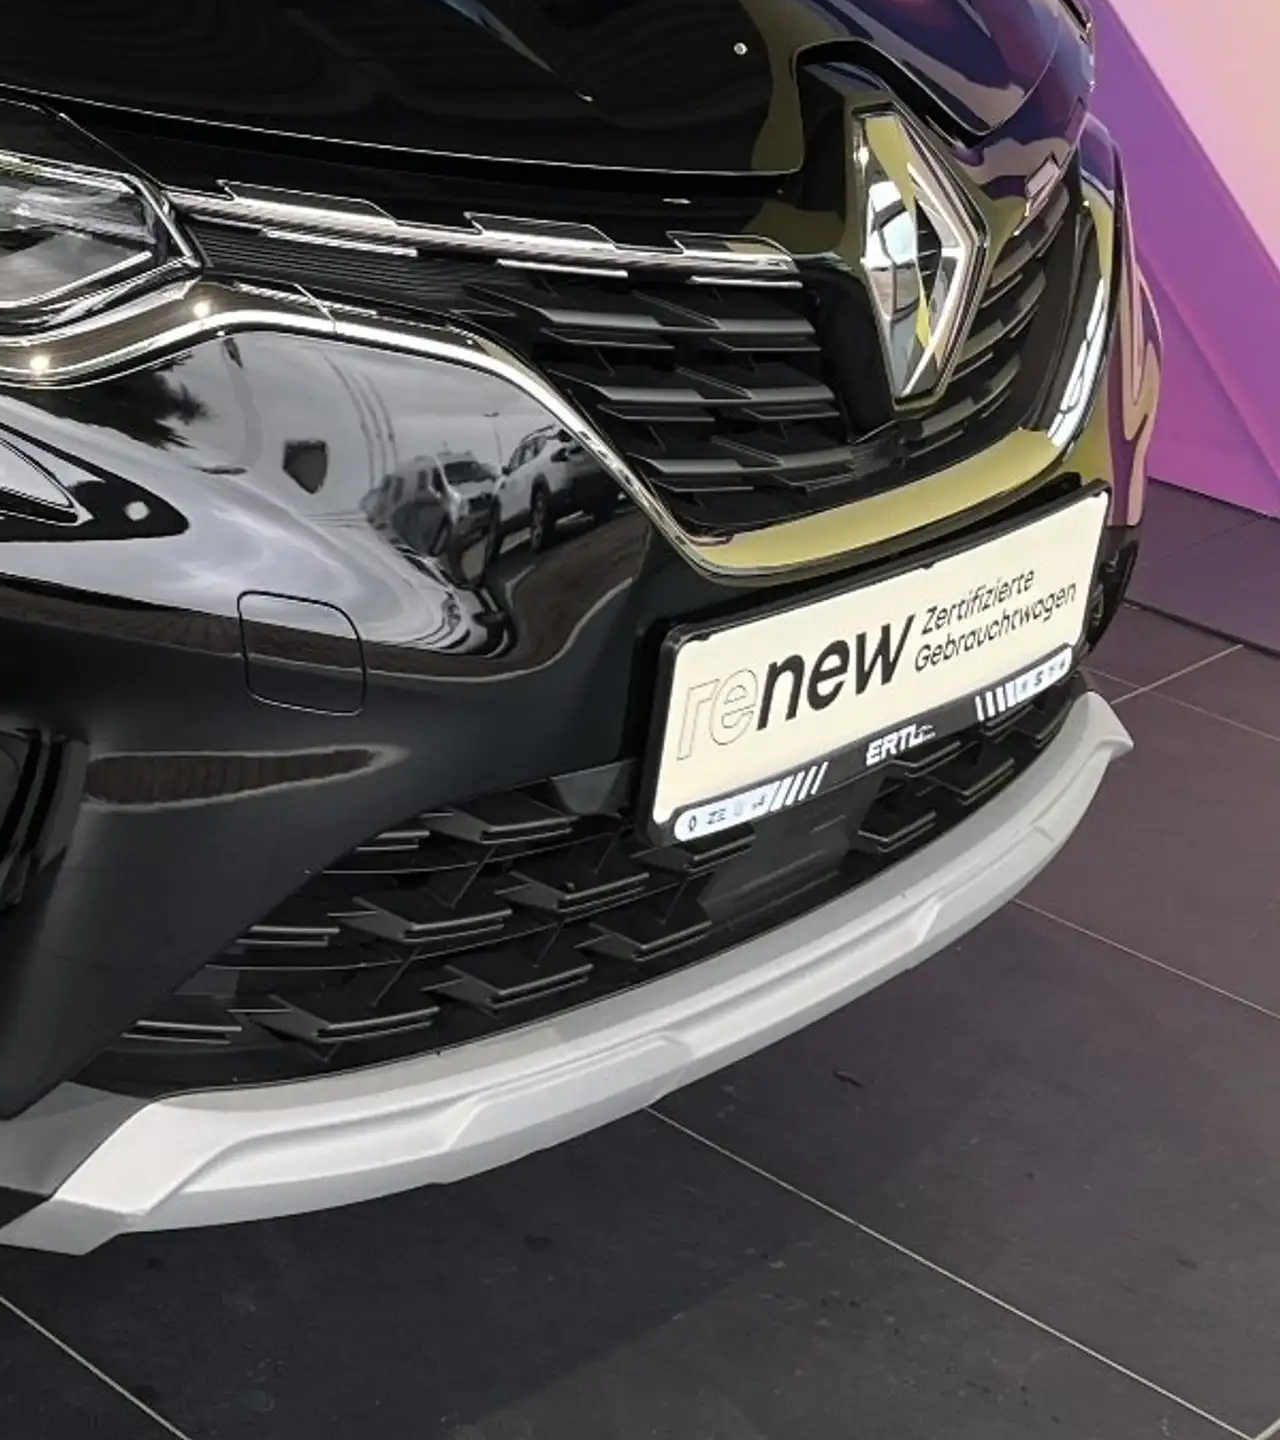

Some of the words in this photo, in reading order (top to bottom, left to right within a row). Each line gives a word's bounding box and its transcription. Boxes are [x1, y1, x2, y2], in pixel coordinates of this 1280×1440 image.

[914, 582, 1077, 672] Gebrauchtwagen
[921, 569, 1035, 636] Zertifizierte
[677, 613, 916, 761] renew
